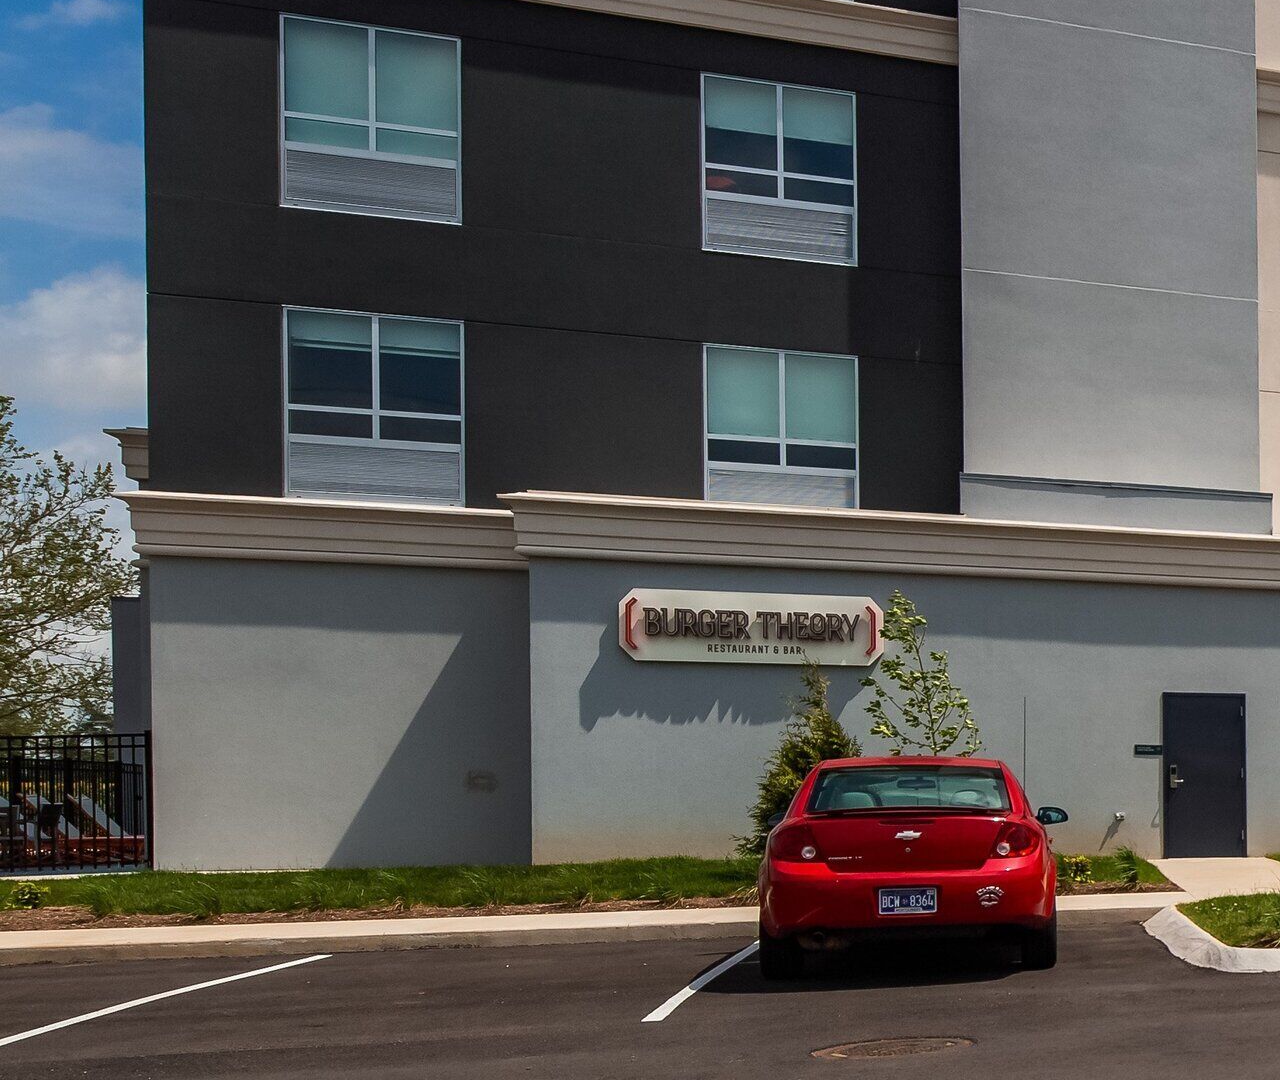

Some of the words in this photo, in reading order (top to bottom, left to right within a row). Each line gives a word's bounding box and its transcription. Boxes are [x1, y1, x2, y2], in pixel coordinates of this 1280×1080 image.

[642, 607, 751, 640] BURGER
[756, 611, 860, 642] THEORY
[707, 643, 769, 654] RESTAURANT
[773, 645, 780, 654] &
[783, 645, 803, 655] BAR
[909, 894, 934, 907] 8364
